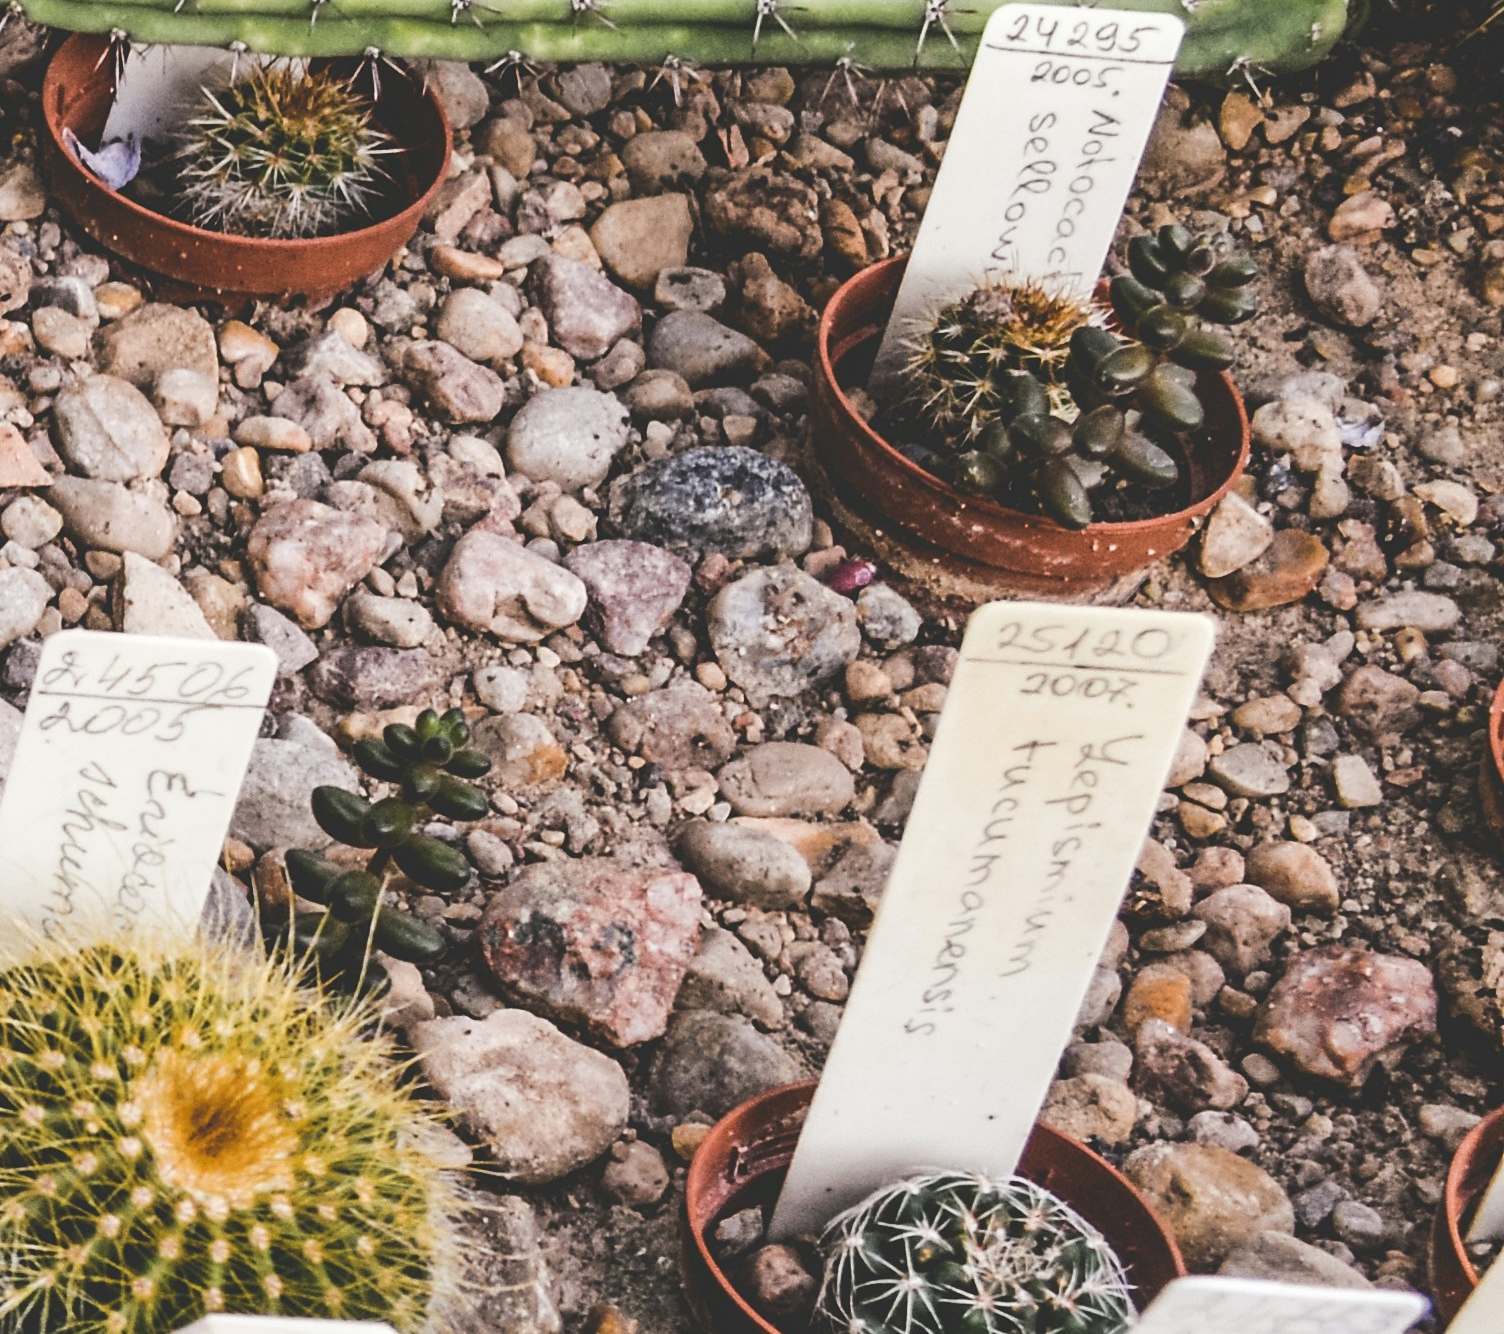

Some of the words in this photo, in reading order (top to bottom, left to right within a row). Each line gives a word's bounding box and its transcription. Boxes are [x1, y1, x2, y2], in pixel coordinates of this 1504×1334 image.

[1003, 11, 1160, 54] 24295
[993, 621, 1172, 663] 25120
[40, 649, 255, 700] 24506
[903, 736, 1062, 1039] tucumanensis
